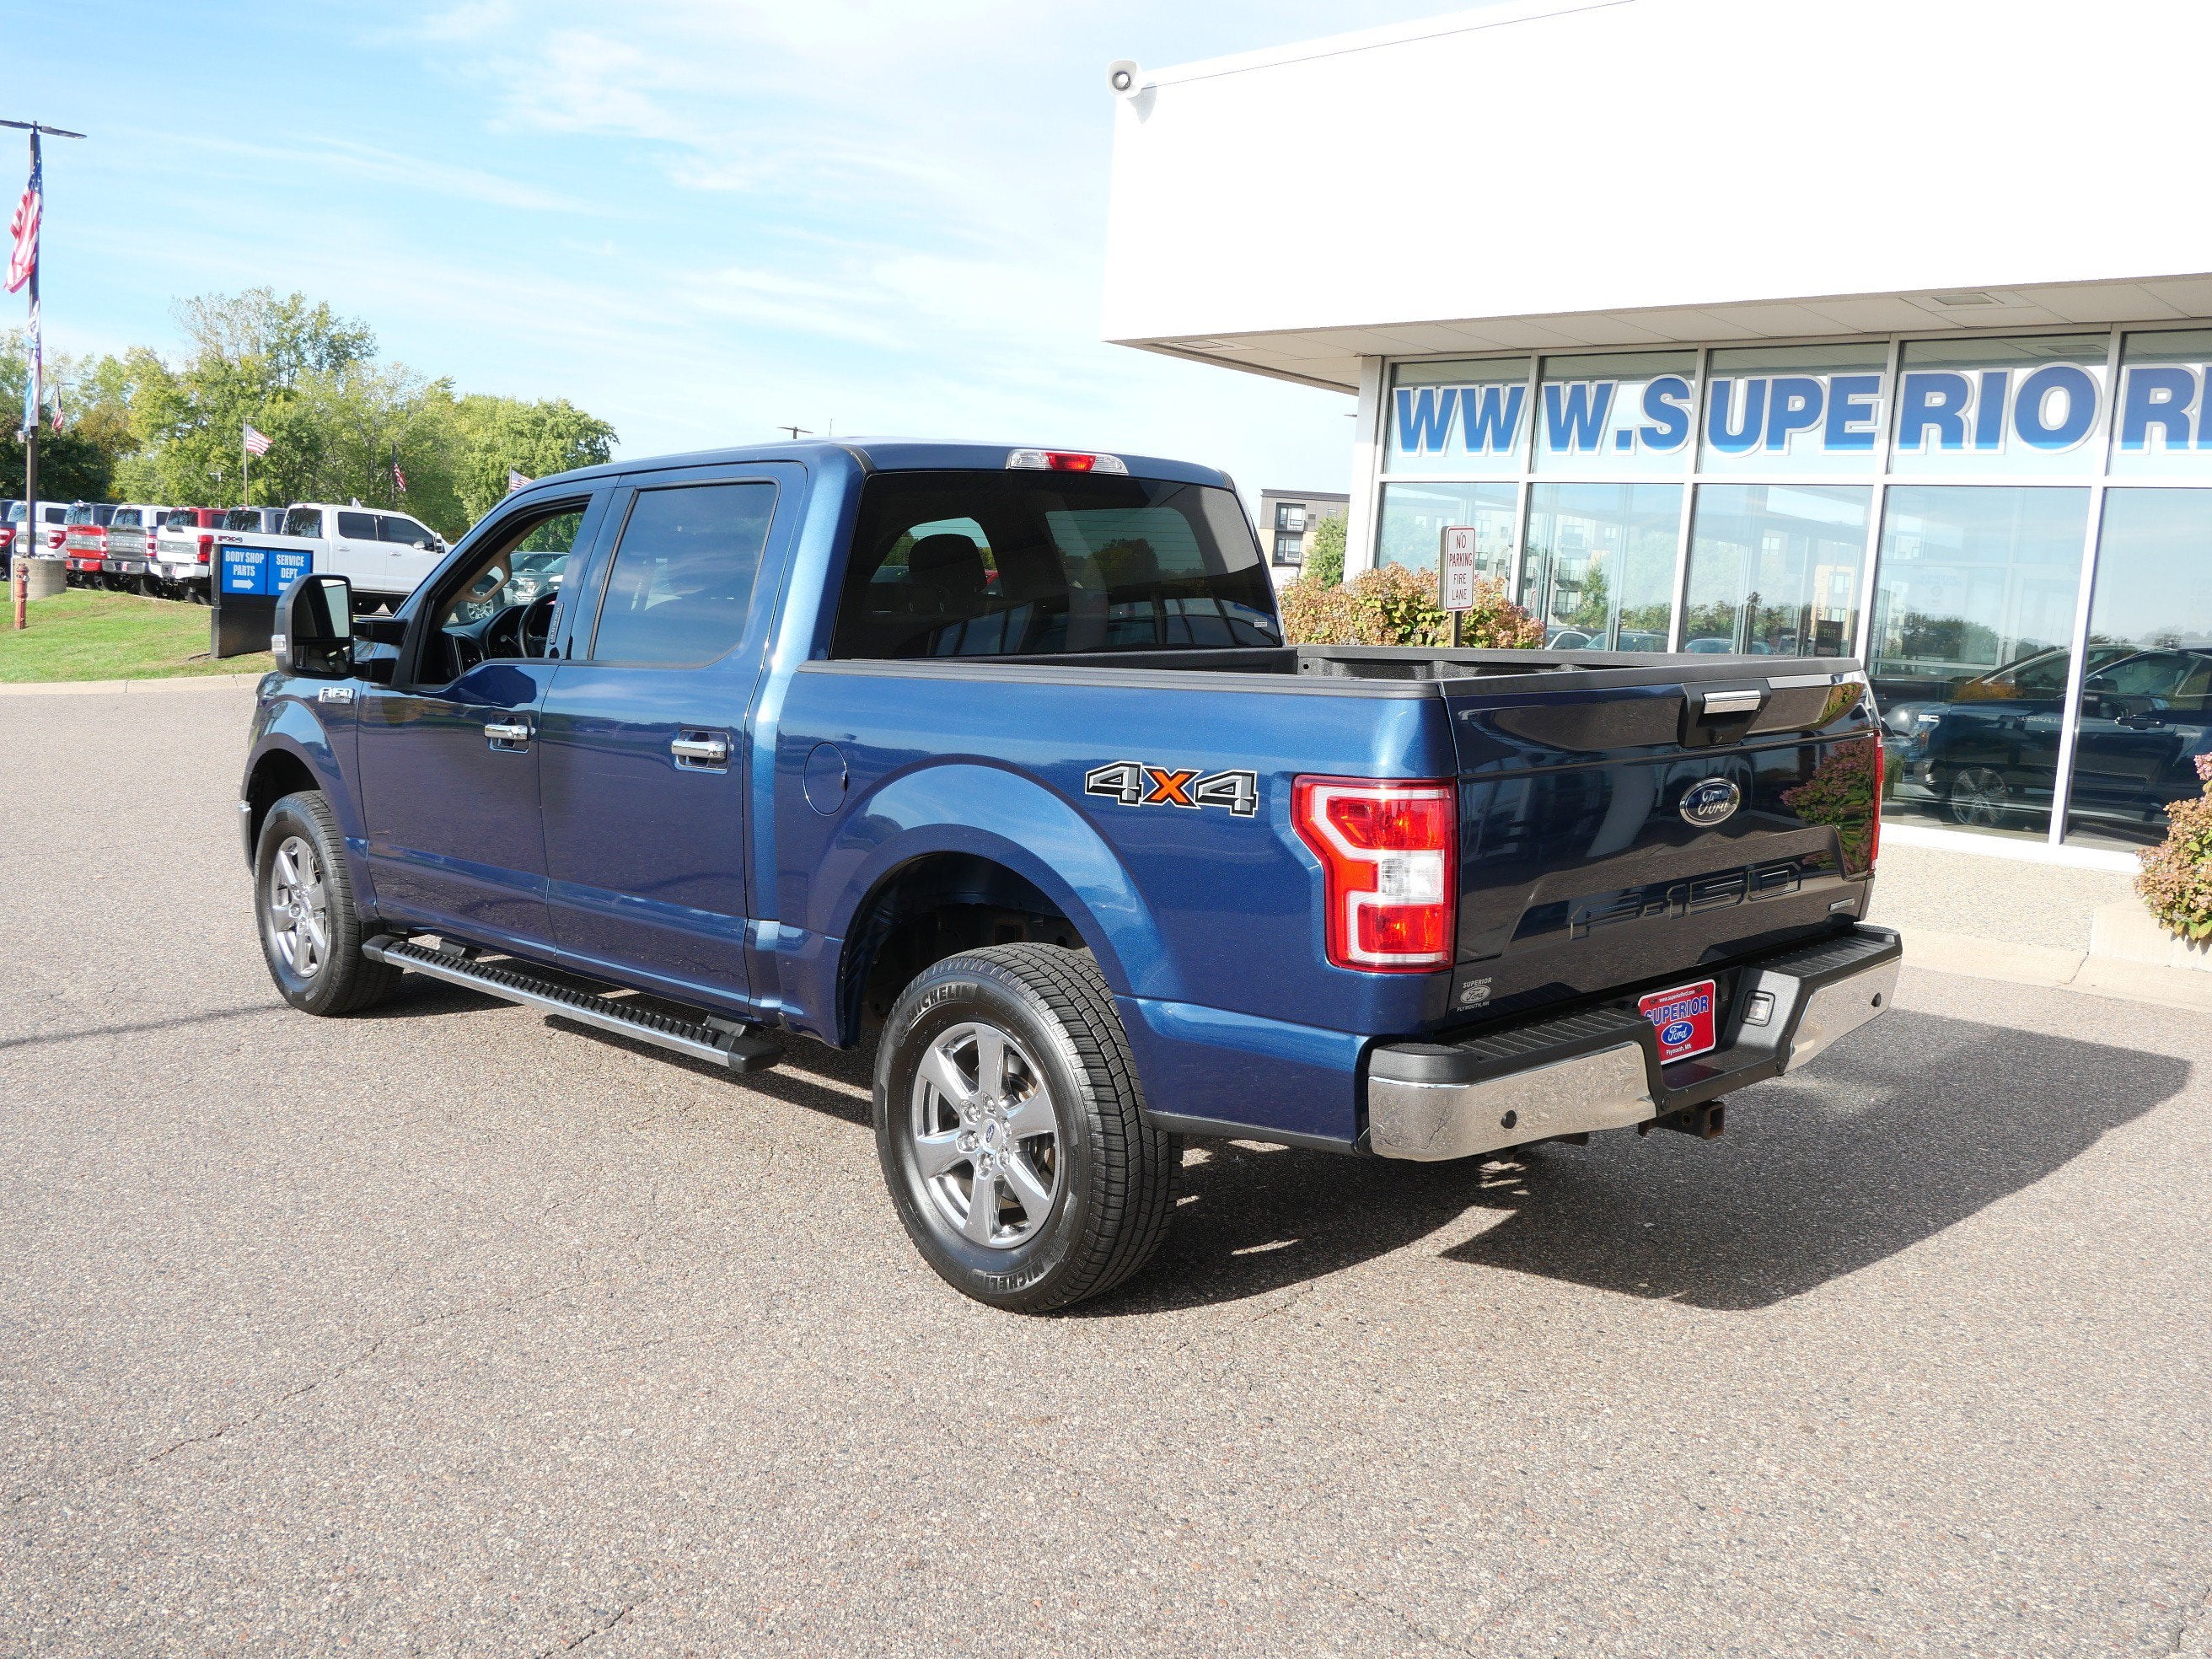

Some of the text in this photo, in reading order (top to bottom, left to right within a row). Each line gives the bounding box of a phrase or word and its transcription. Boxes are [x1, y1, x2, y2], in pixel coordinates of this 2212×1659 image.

[1393, 362, 2212, 458] WWW.SUPERIOR
[1456, 534, 1467, 549] NO
[225, 550, 265, 564] BODY SHOP
[276, 554, 304, 566] SERVICE
[1449, 552, 1473, 567] PARKING
[233, 564, 255, 577] PARTS
[1453, 573, 1467, 584] FIRE
[1452, 589, 1467, 601] LANE
[1570, 862, 1801, 942] F-150
[1463, 977, 1492, 989] SUPERIOR
[906, 985, 972, 1025] MICHELIN
[1667, 1024, 1688, 1042] Ford
